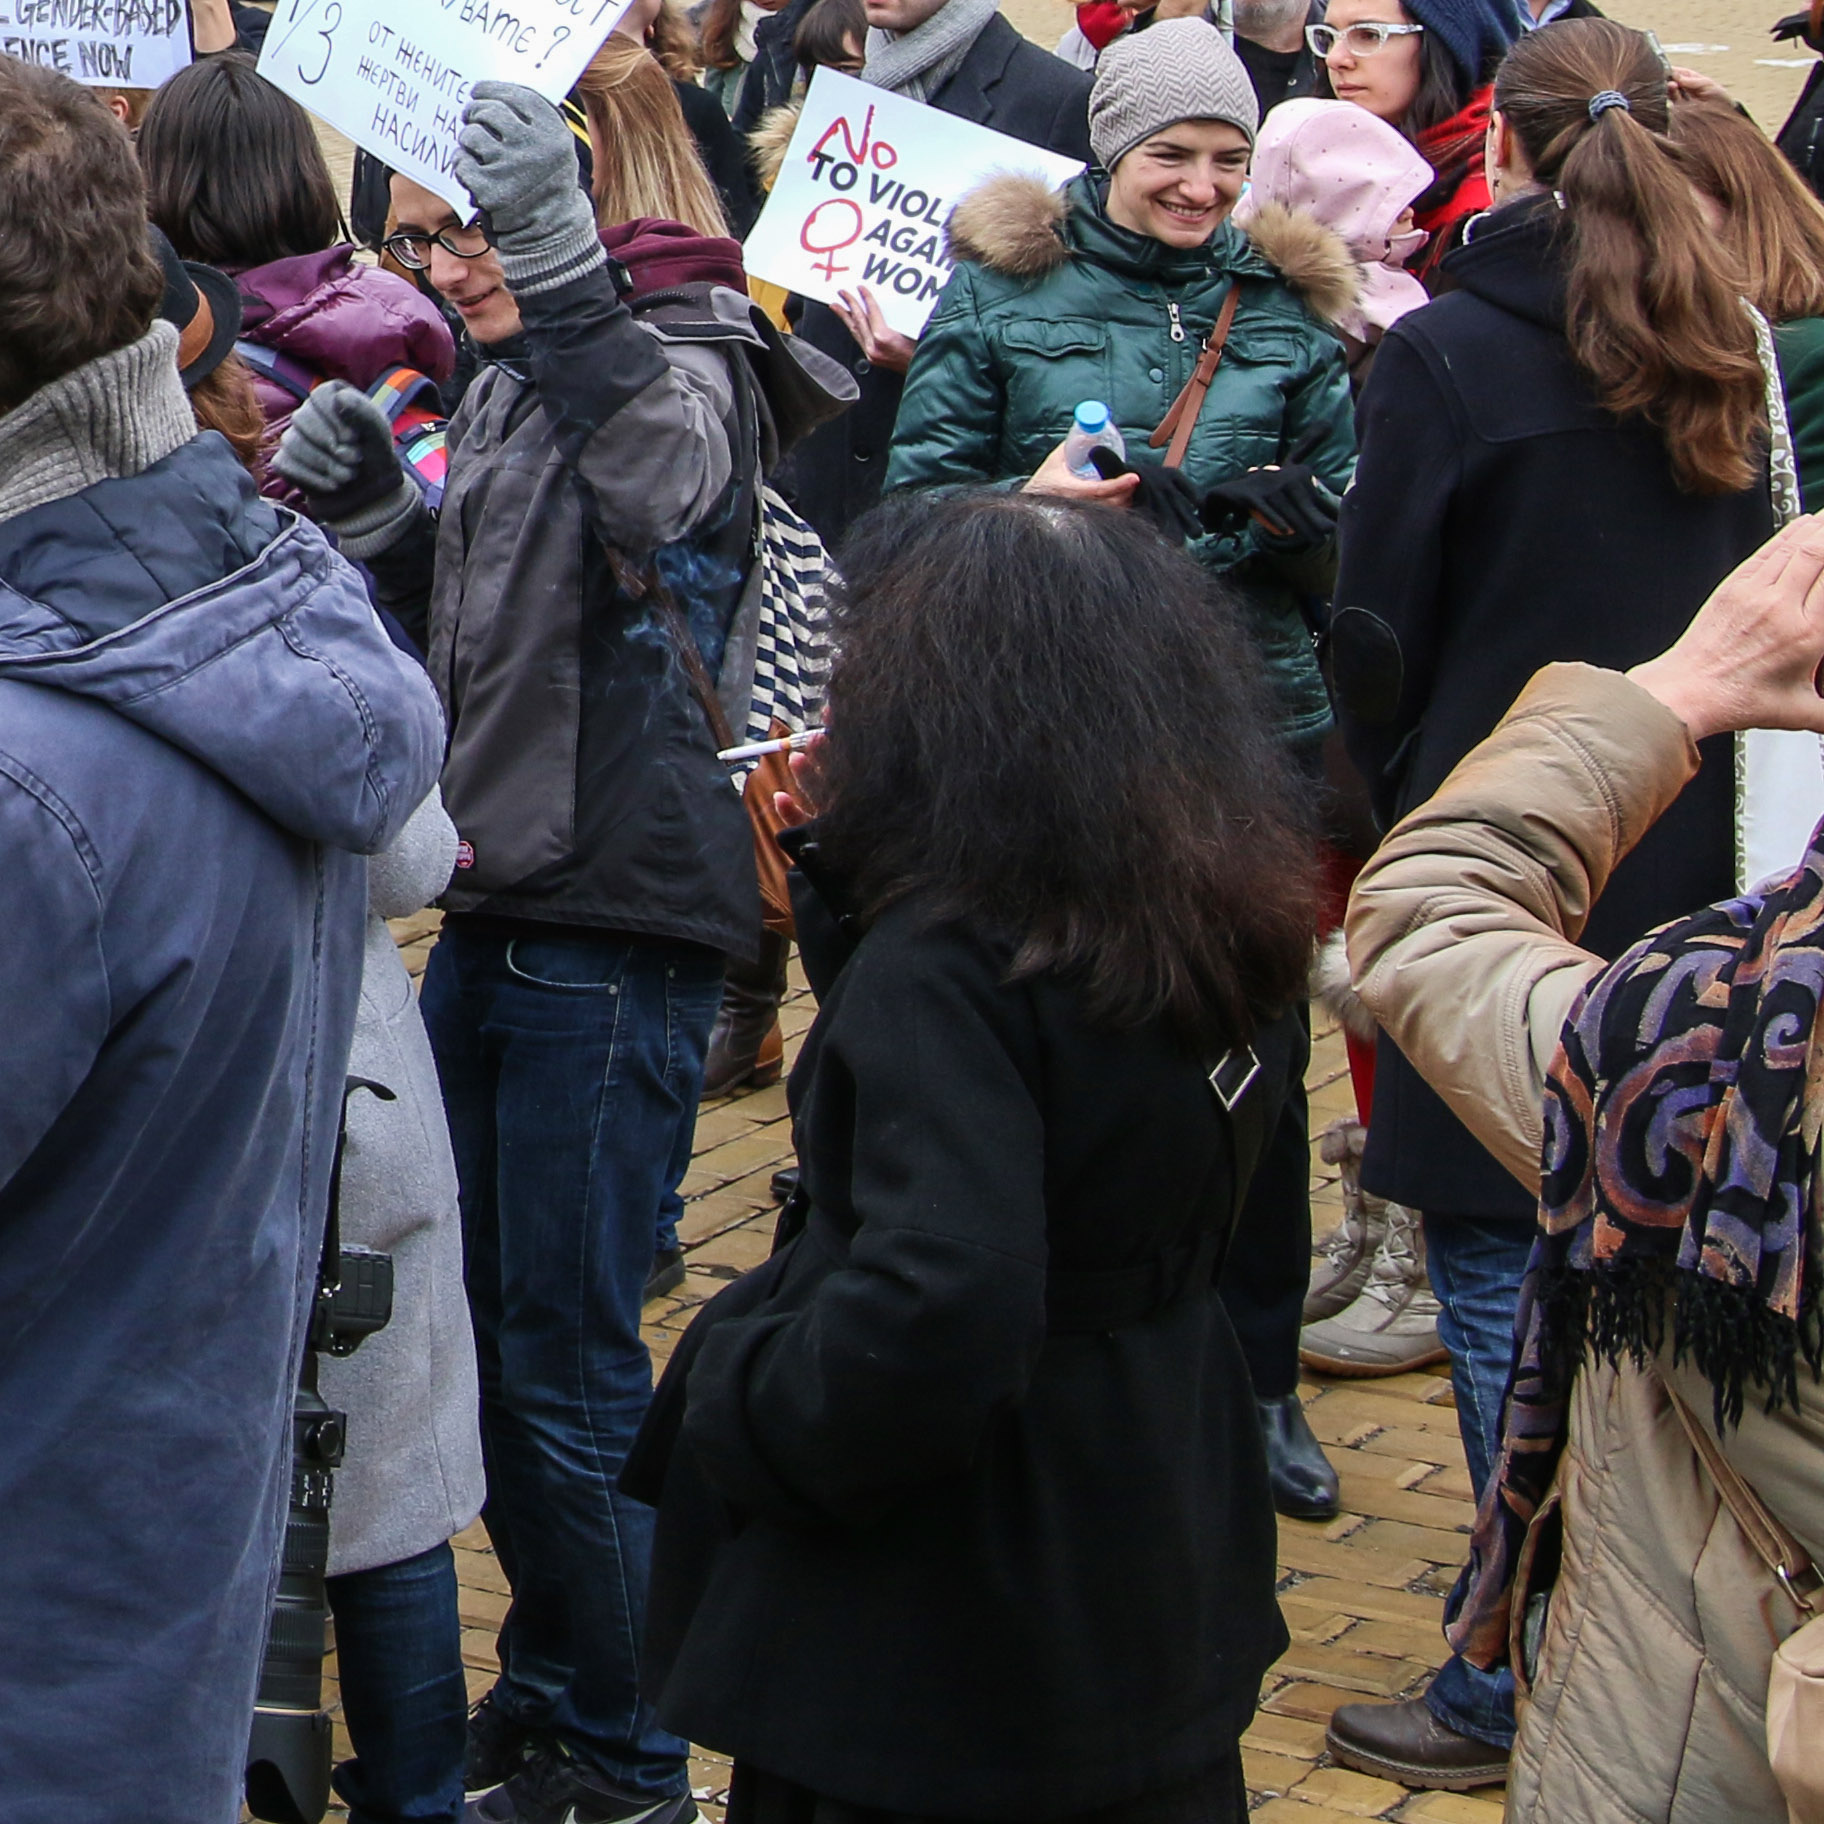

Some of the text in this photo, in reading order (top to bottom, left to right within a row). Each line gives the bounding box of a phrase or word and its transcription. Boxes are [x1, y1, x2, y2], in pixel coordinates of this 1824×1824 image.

[78, 41, 133, 82] NOW
[357, 55, 457, 141] ЖЕРТВИ НА
[369, 21, 469, 104] ОТ ЖЕНИТЕ
[371, 102, 455, 179] НАСИЛИ
[809, 151, 948, 230] TO VIOL
